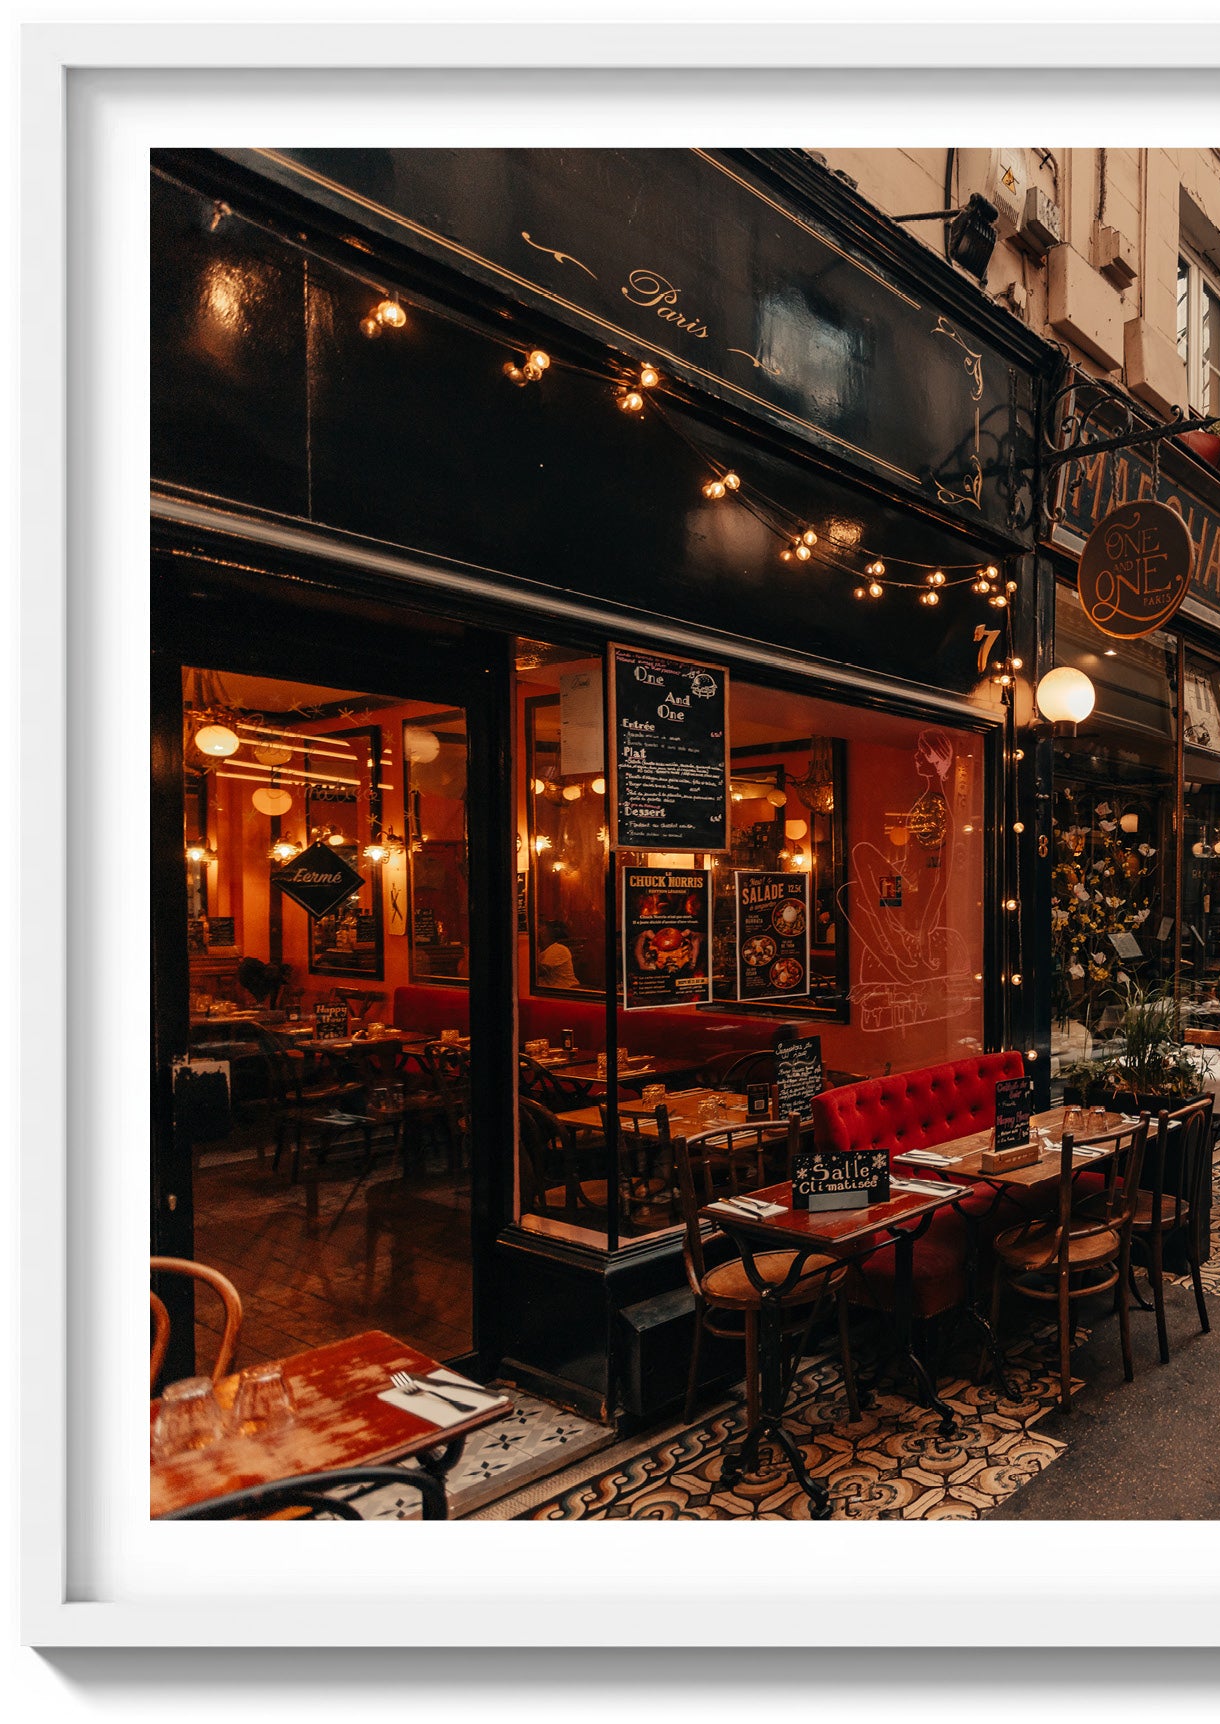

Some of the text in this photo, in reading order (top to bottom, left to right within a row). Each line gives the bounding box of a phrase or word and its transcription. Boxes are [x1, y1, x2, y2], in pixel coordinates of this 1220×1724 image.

[621, 269, 709, 338] Paris
[1104, 512, 1160, 560] ONE
[1113, 560, 1134, 573] AND
[1092, 553, 1173, 622] ONE
[1143, 593, 1172, 606] PARIS
[973, 624, 1001, 672] 7
[633, 665, 665, 685] One
[665, 691, 691, 706] And
[657, 703, 685, 720] One
[622, 718, 655, 731] Entrée
[623, 746, 647, 759] Plat
[624, 806, 667, 818] Dessert
[1038, 834, 1049, 858] 8
[629, 875, 704, 888] CHUCK NORRIS
[742, 883, 784, 905] SALADE
[316, 1004, 347, 1017] Happy
[811, 1162, 870, 1182] Salle
[799, 1178, 878, 1195] Climatisée
